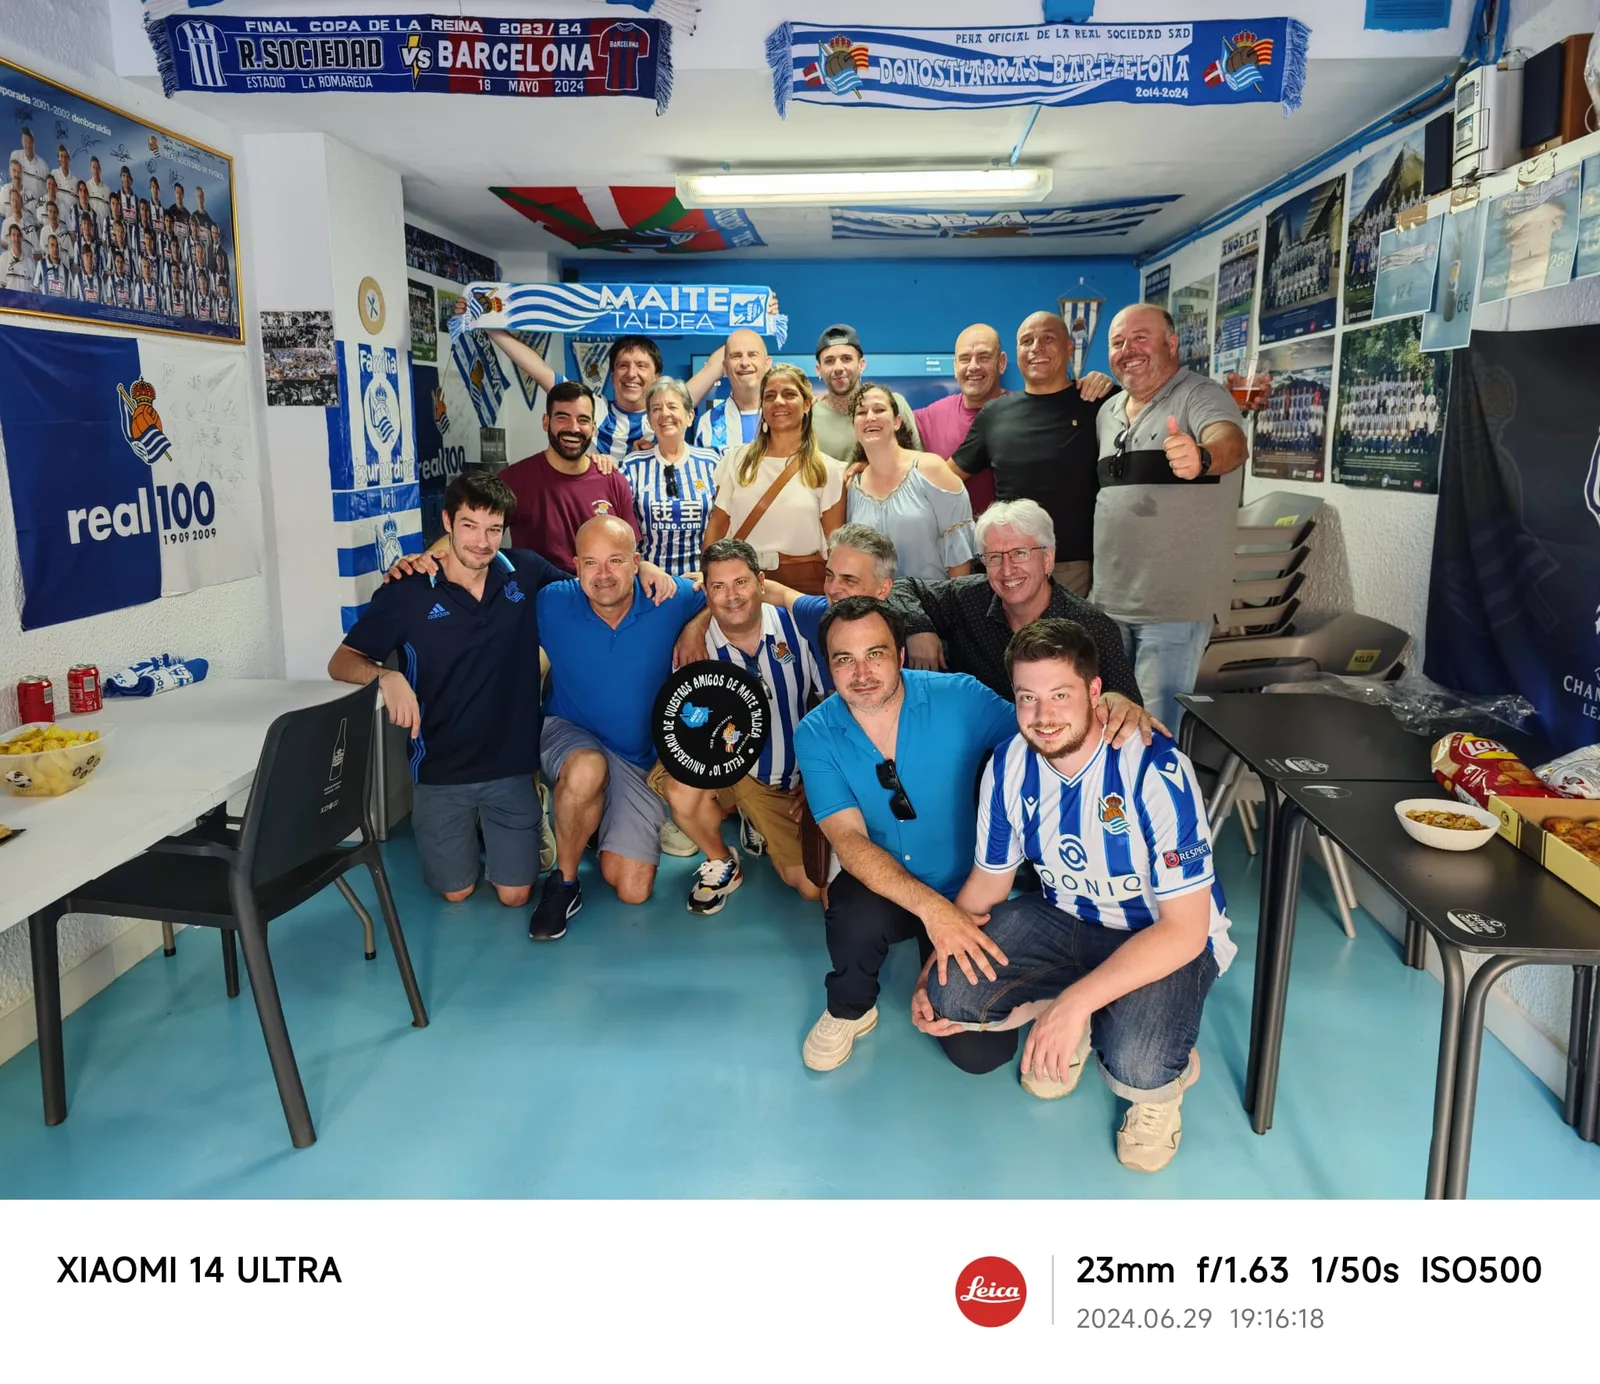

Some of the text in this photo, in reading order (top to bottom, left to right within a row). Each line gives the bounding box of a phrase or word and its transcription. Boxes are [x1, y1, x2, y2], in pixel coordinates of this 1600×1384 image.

[245, 20, 298, 33] FINAL
[309, 20, 361, 33] COPA
[369, 19, 390, 32] DE
[396, 19, 421, 32] LA
[431, 18, 483, 34] REINA
[987, 31, 1030, 43] OFICIAL
[1036, 29, 1050, 40] DE
[1055, 29, 1070, 40] LA
[1075, 29, 1101, 40] REAL
[1107, 29, 1162, 40] SOCIEDAD
[1168, 28, 1191, 39] SAD
[236, 36, 385, 71] R.SOCIEDAD
[438, 40, 595, 72] BARCELONA
[1052, 52, 1190, 84] BARTZELONA
[246, 75, 373, 89] ESTADIO LA ROMAREDA
[478, 79, 584, 93] 18 MAYO 2024
[1135, 86, 1189, 98] 2014-2024
[599, 285, 729, 312] MAITE
[609, 311, 716, 330] TALDEA
[359, 348, 397, 375] Familia
[67, 481, 216, 545] real 100
[163, 527, 217, 546] 1909 2009
[692, 673, 725, 688] AMIGOS
[726, 677, 740, 691] DE
[737, 683, 758, 709] MAITE
[663, 719, 675, 731] DE
[750, 708, 763, 739] TALDEA
[724, 754, 745, 775] FELIZ
[1179, 843, 1210, 862] RESPECT
